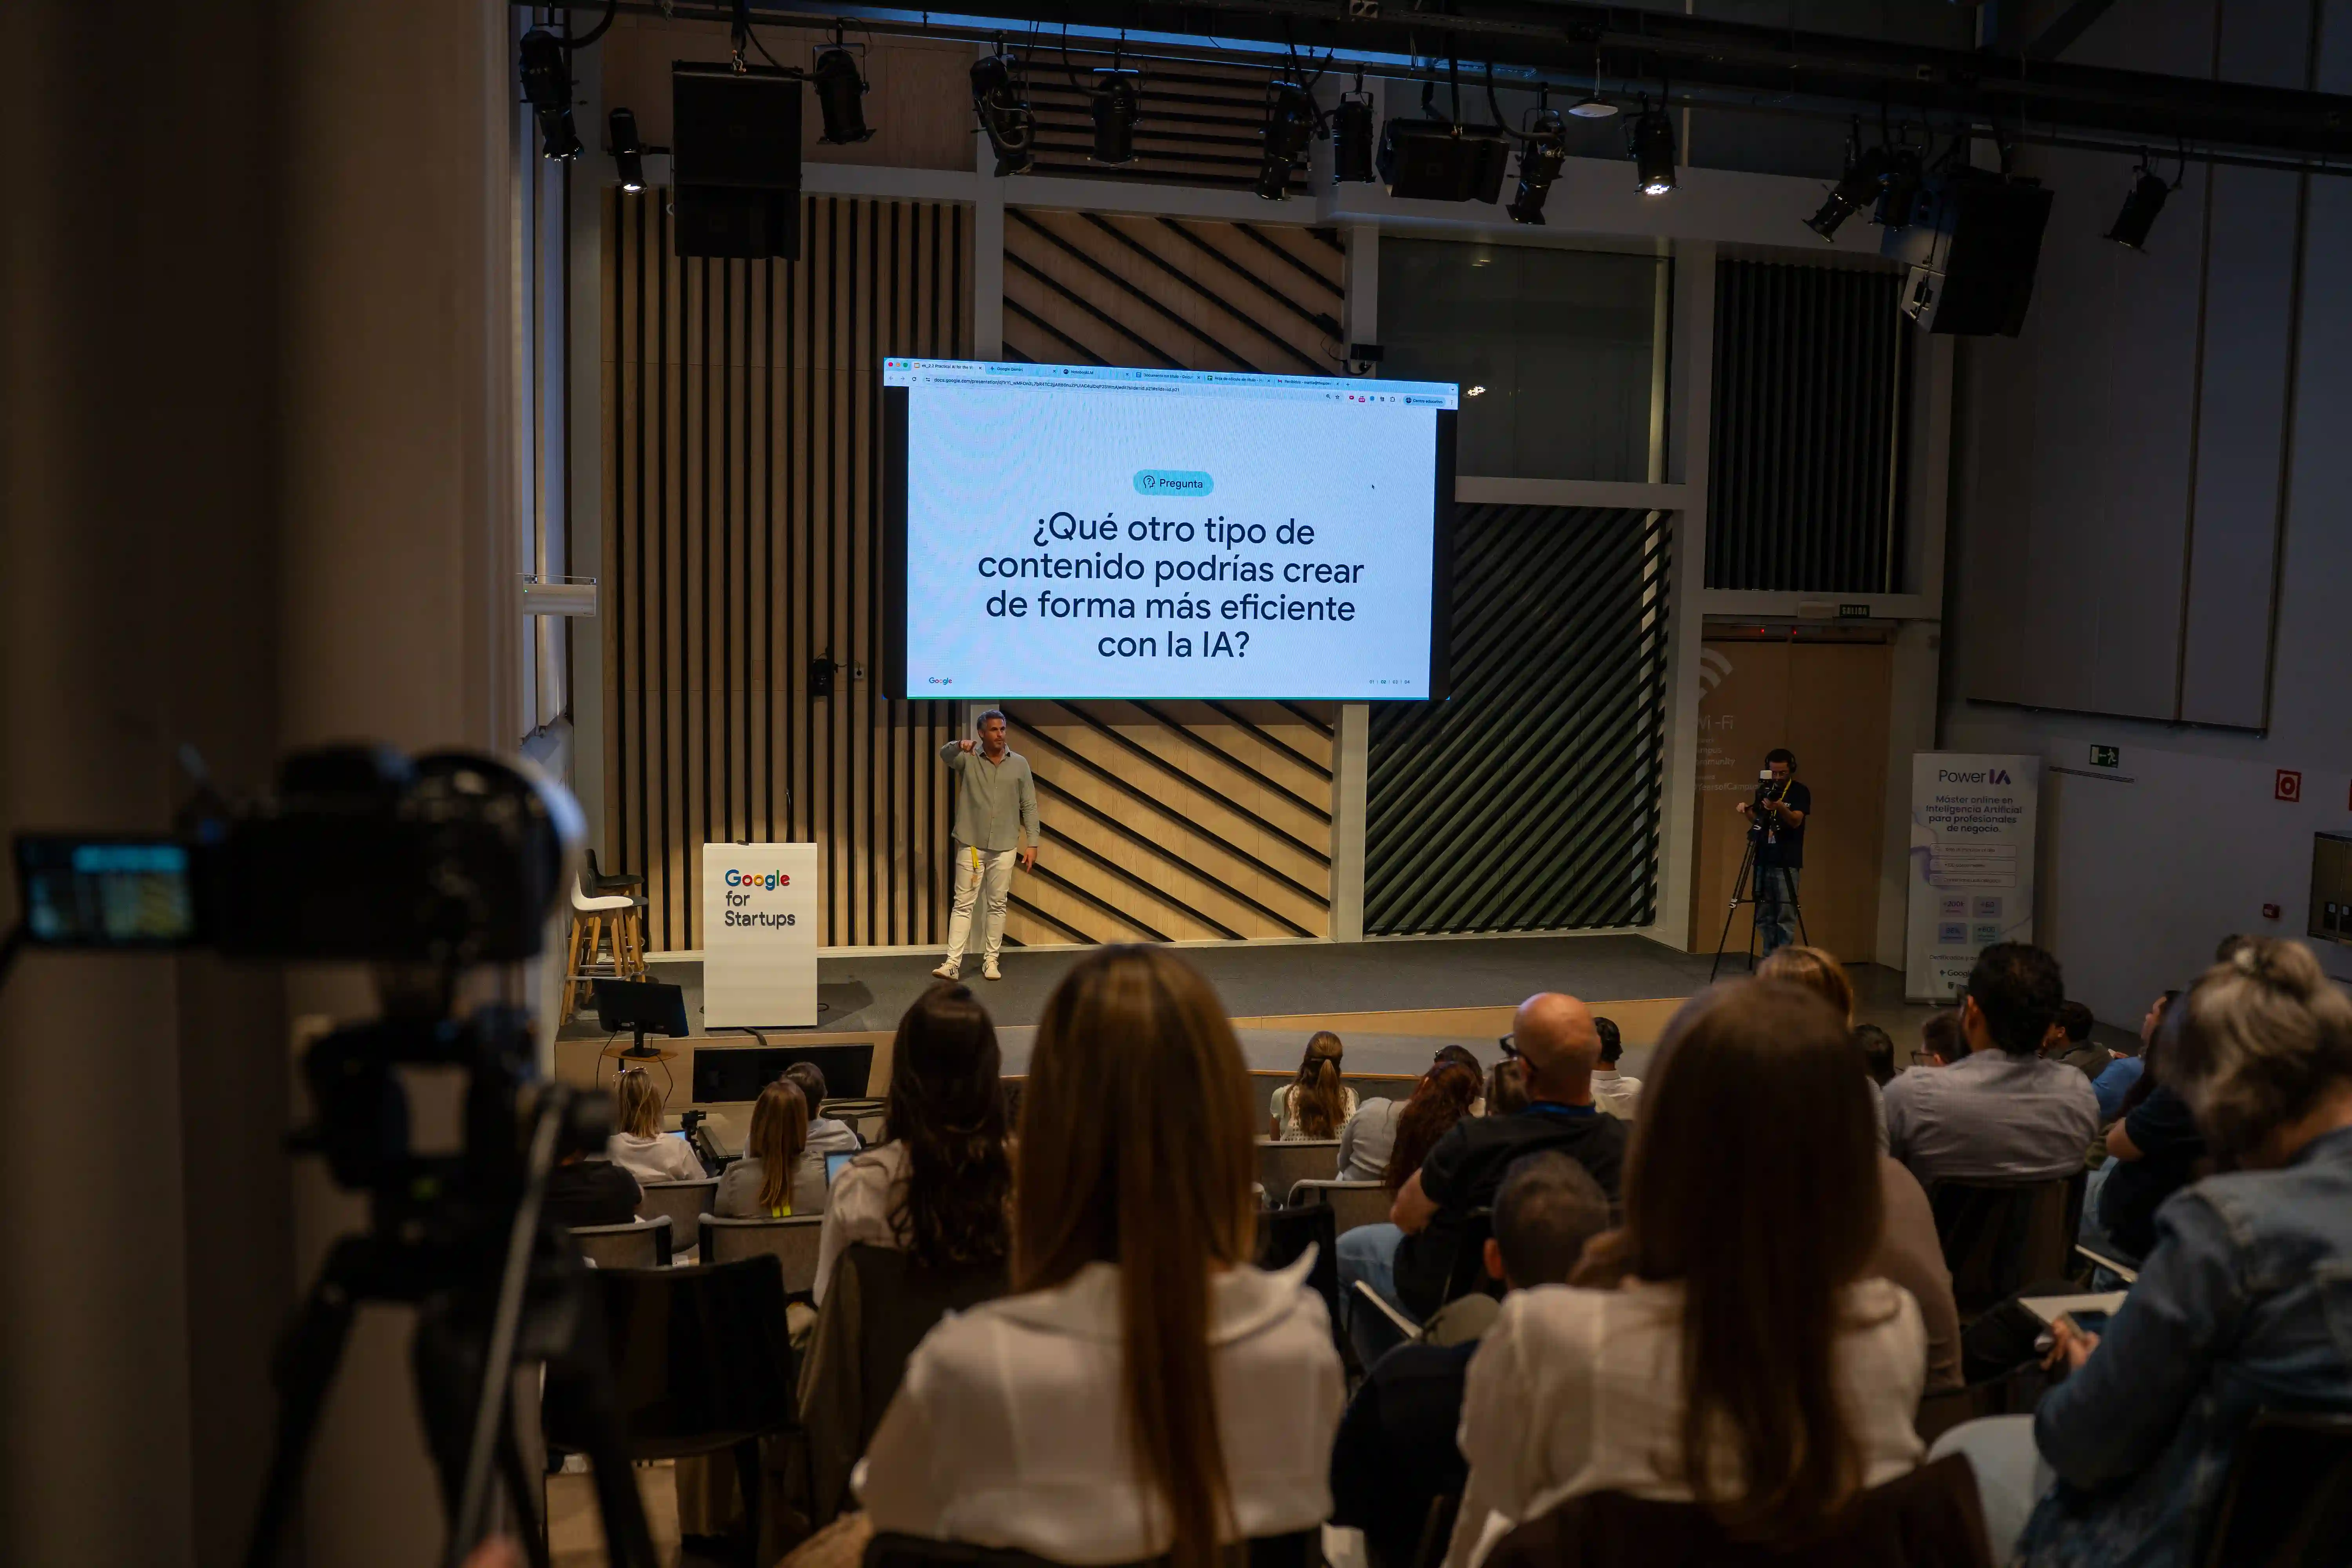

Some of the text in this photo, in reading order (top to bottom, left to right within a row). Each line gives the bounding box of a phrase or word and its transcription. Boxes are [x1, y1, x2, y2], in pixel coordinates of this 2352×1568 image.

[1159, 478, 1203, 491] Pregunta
[1033, 511, 1315, 551] ¿Qué otro tipo de
[978, 551, 1365, 588] contenido podrías crear
[986, 589, 1356, 622] de forma más eficiente
[1842, 606, 1867, 615] SALIDA
[1098, 630, 1250, 658] con la IA?
[929, 677, 952, 685] Google
[1936, 795, 1969, 803] Máster
[1926, 805, 1981, 815] Inteligencia
[1929, 815, 2017, 824] para profesionales
[1960, 825, 2002, 834] negocio.
[725, 869, 790, 891] Google
[726, 890, 751, 907] for
[724, 910, 796, 930] Startups
[1947, 969, 1970, 978] Googl
